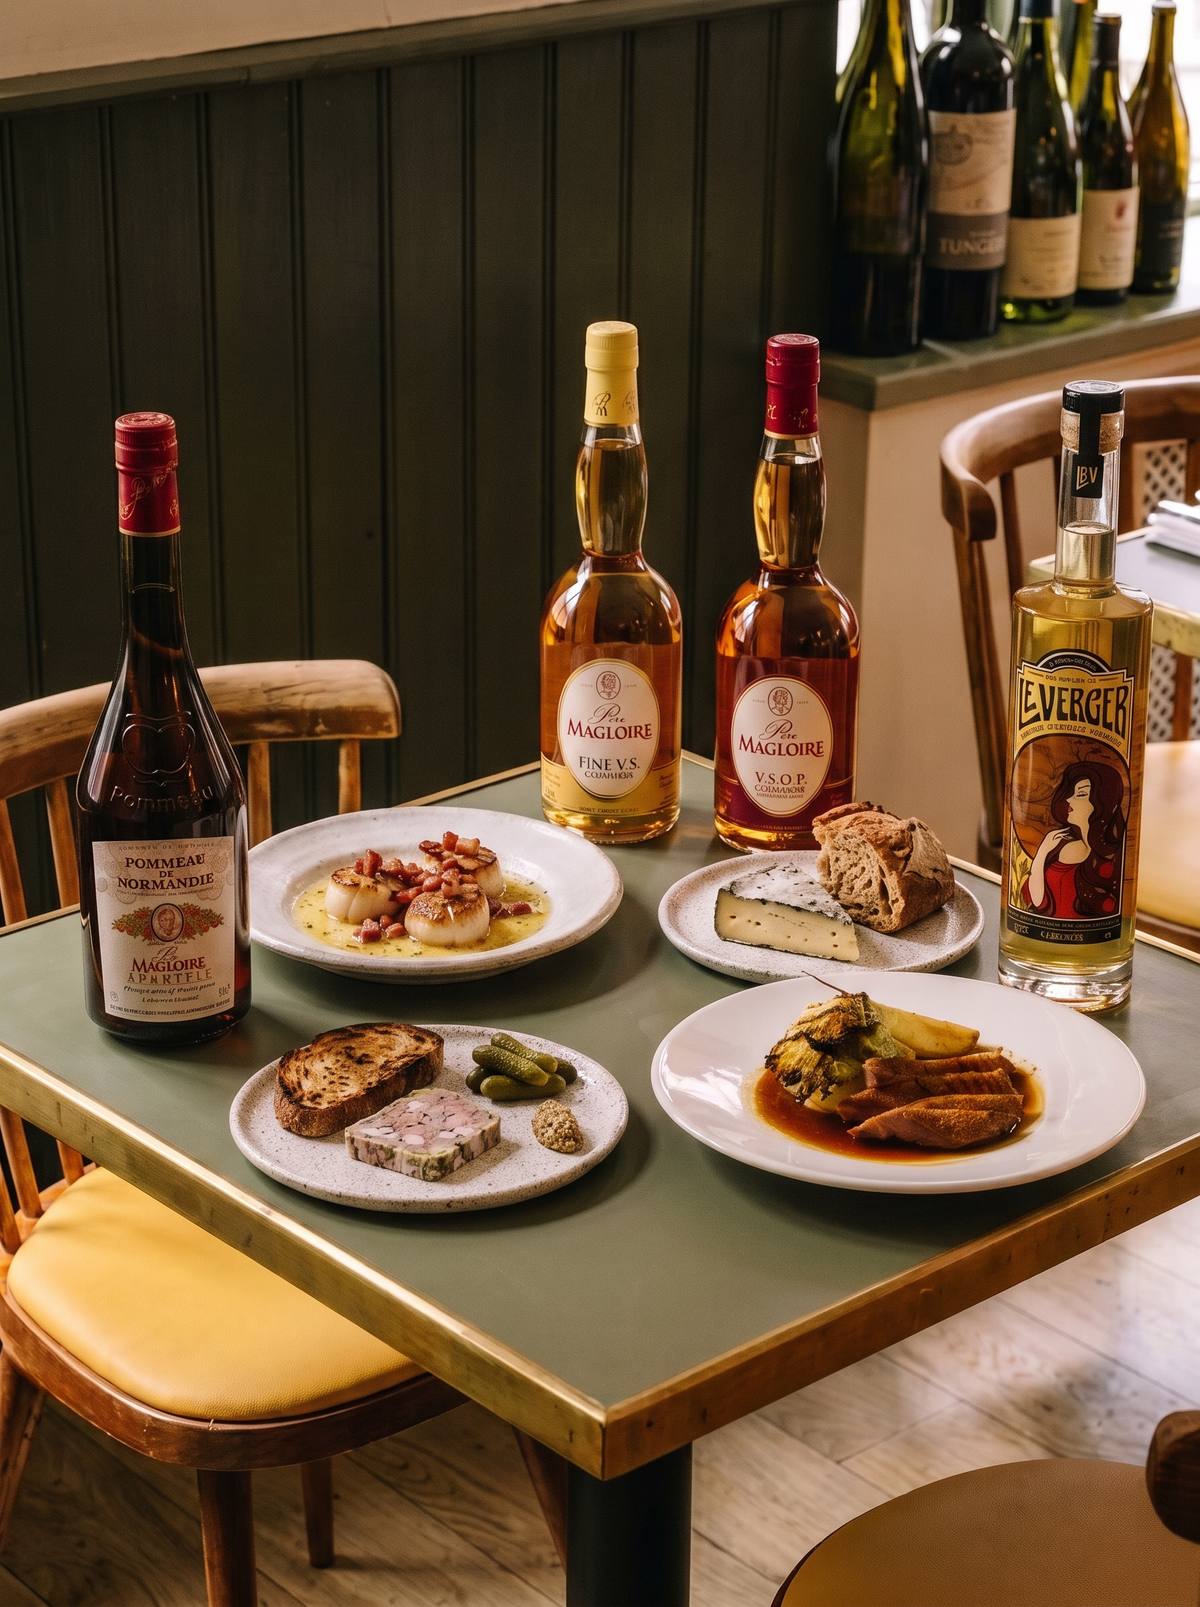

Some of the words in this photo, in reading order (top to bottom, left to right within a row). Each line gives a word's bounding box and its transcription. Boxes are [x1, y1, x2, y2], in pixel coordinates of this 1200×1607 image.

[1038, 682, 1130, 740] VERGER
[567, 718, 652, 740] MAGLOIRE
[739, 734, 824, 757] MAGLOIRE
[579, 756, 612, 771] FINE
[616, 757, 640, 771] V.S.
[755, 771, 808, 786] V.S.O.P.
[125, 853, 206, 870] POMMEAU
[117, 872, 214, 890] NORMANDIE
[159, 870, 174, 878] DE
[131, 956, 206, 974] MAGLOIRE
